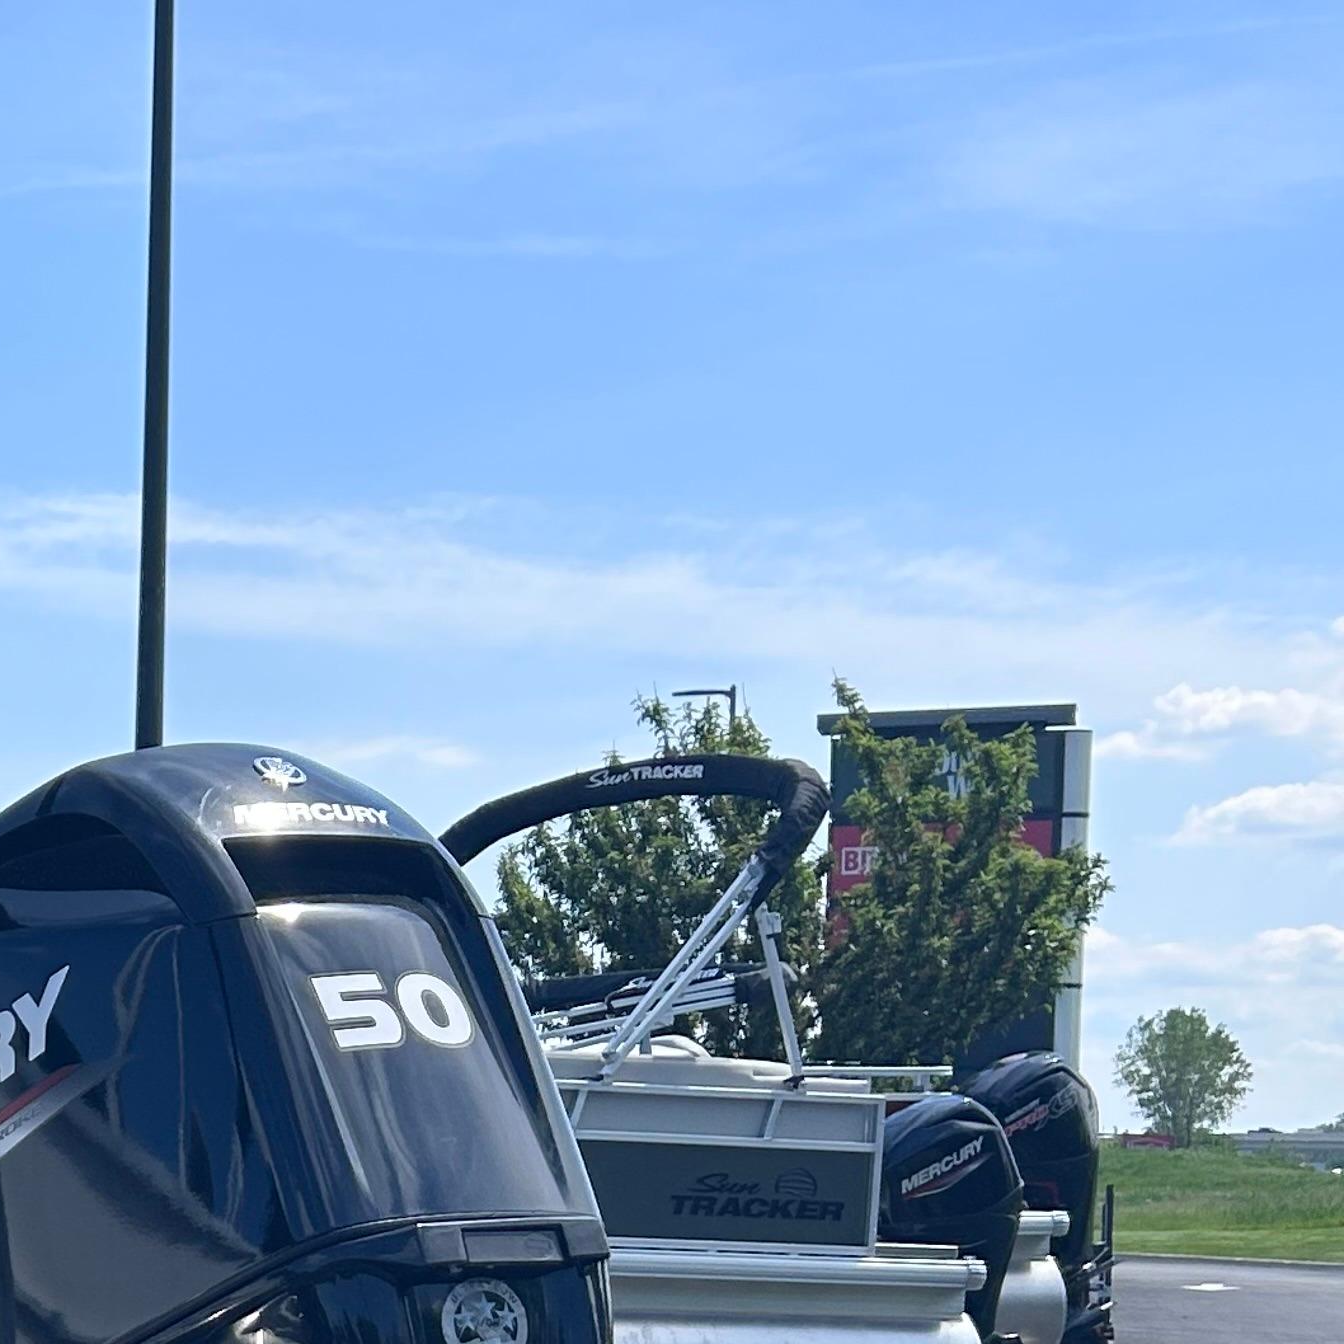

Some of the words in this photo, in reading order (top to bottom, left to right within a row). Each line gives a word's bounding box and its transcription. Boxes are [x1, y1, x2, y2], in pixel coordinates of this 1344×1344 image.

[585, 768, 632, 789] Sun
[629, 764, 705, 780] TRACKER
[233, 801, 389, 827] MERCURY
[309, 971, 474, 1051] 50
[901, 1135, 984, 1194] MERCURY
[687, 1172, 761, 1195] Sun
[671, 1194, 845, 1221] TRACKER
